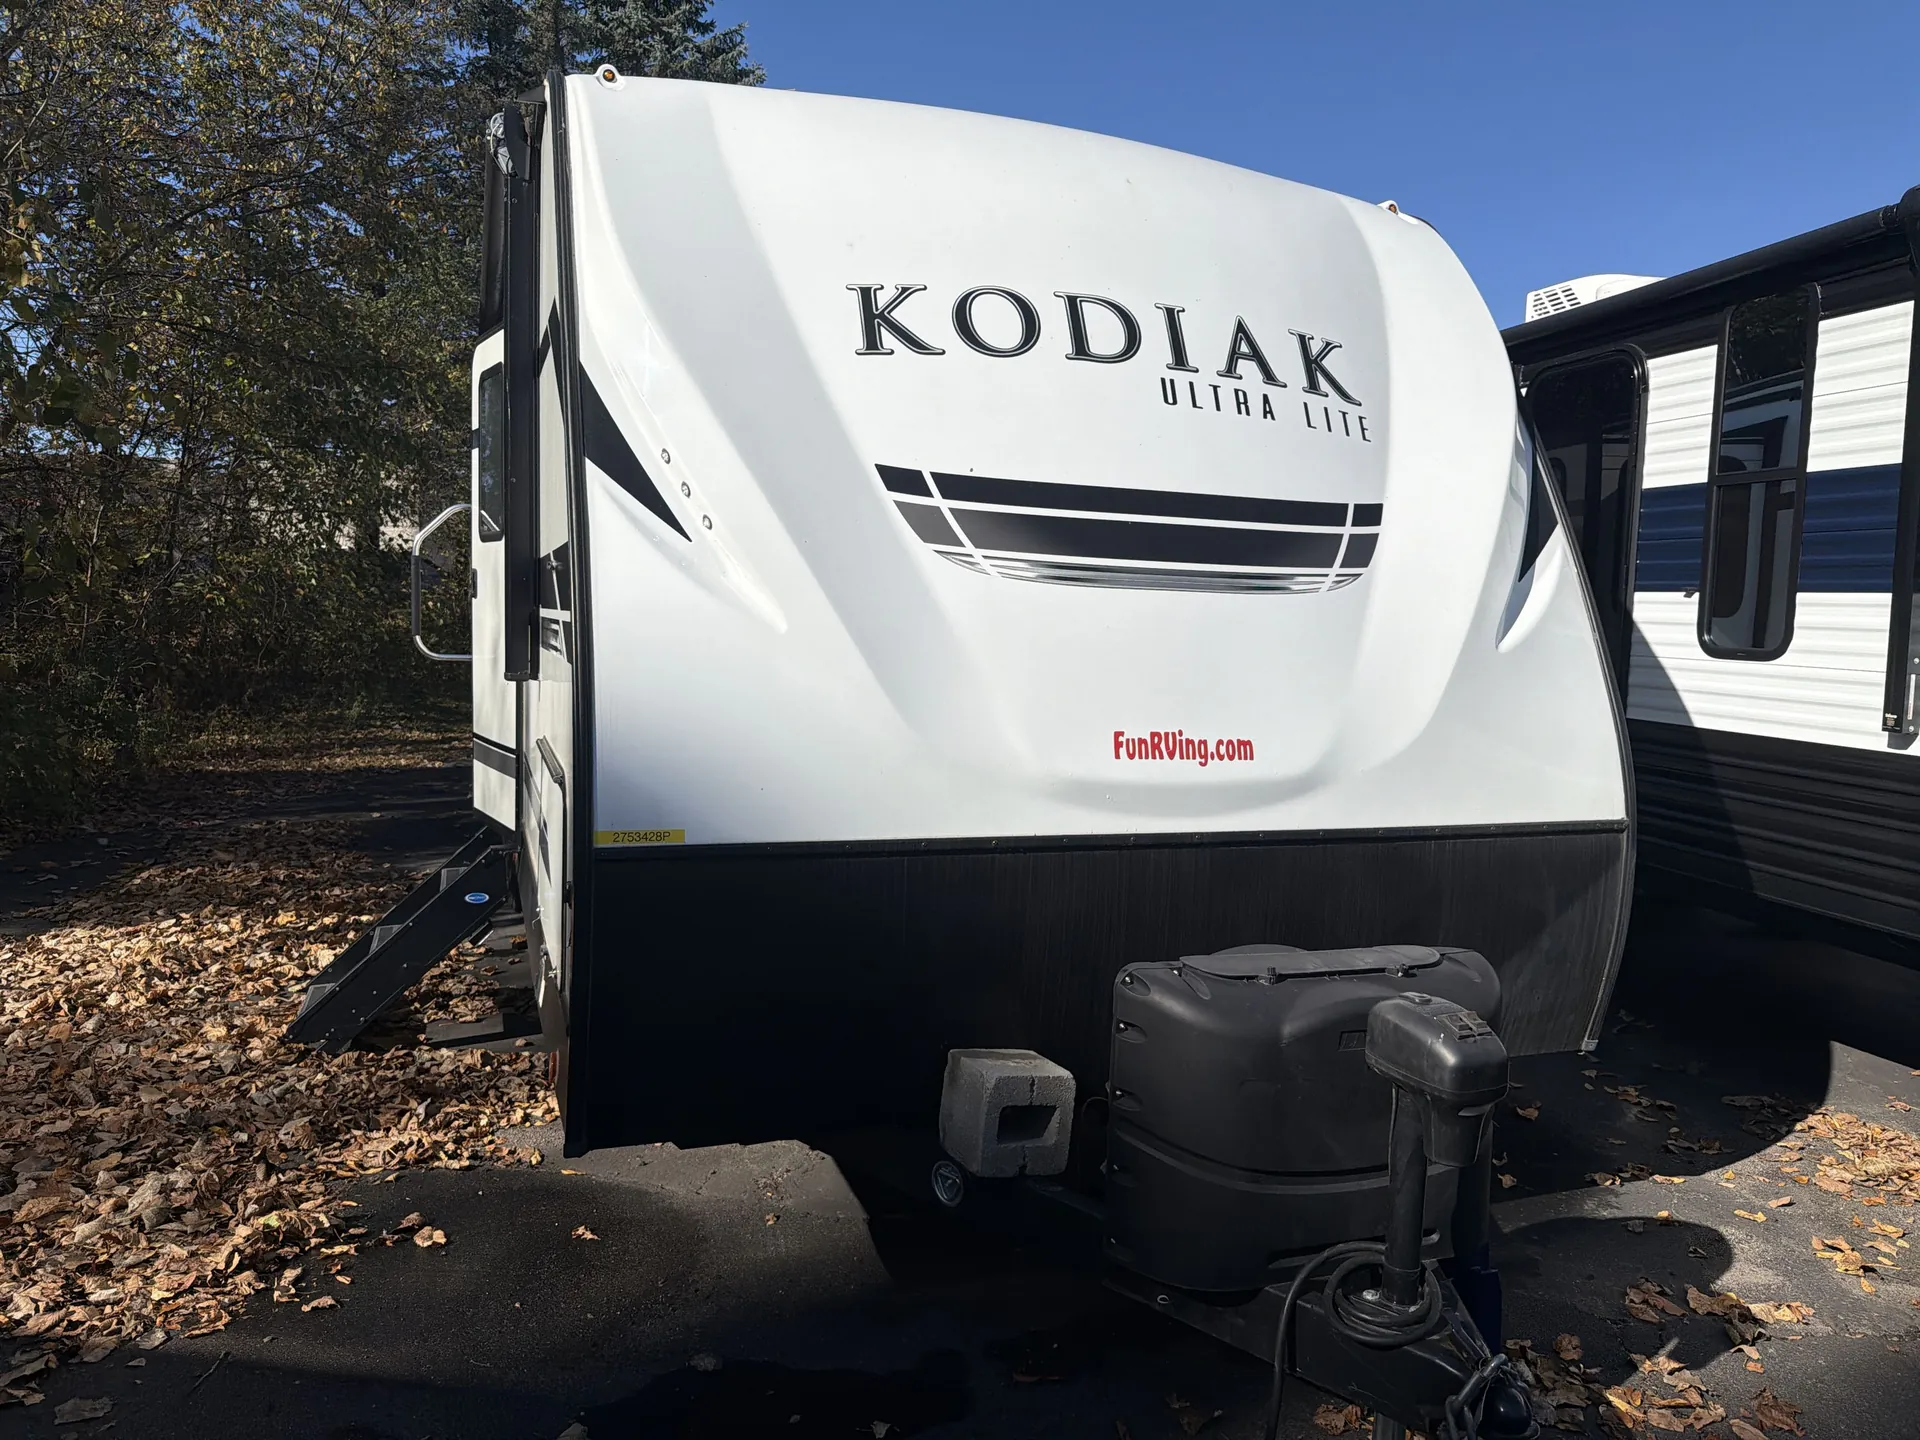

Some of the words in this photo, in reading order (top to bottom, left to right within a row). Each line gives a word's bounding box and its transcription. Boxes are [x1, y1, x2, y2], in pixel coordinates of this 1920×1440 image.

[845, 283, 1363, 407] KODIAK
[1160, 376, 1276, 421] ULTRA
[1302, 401, 1372, 443] LITE
[1113, 728, 1255, 767] FunRVing.com
[612, 831, 671, 843] 2753428P
